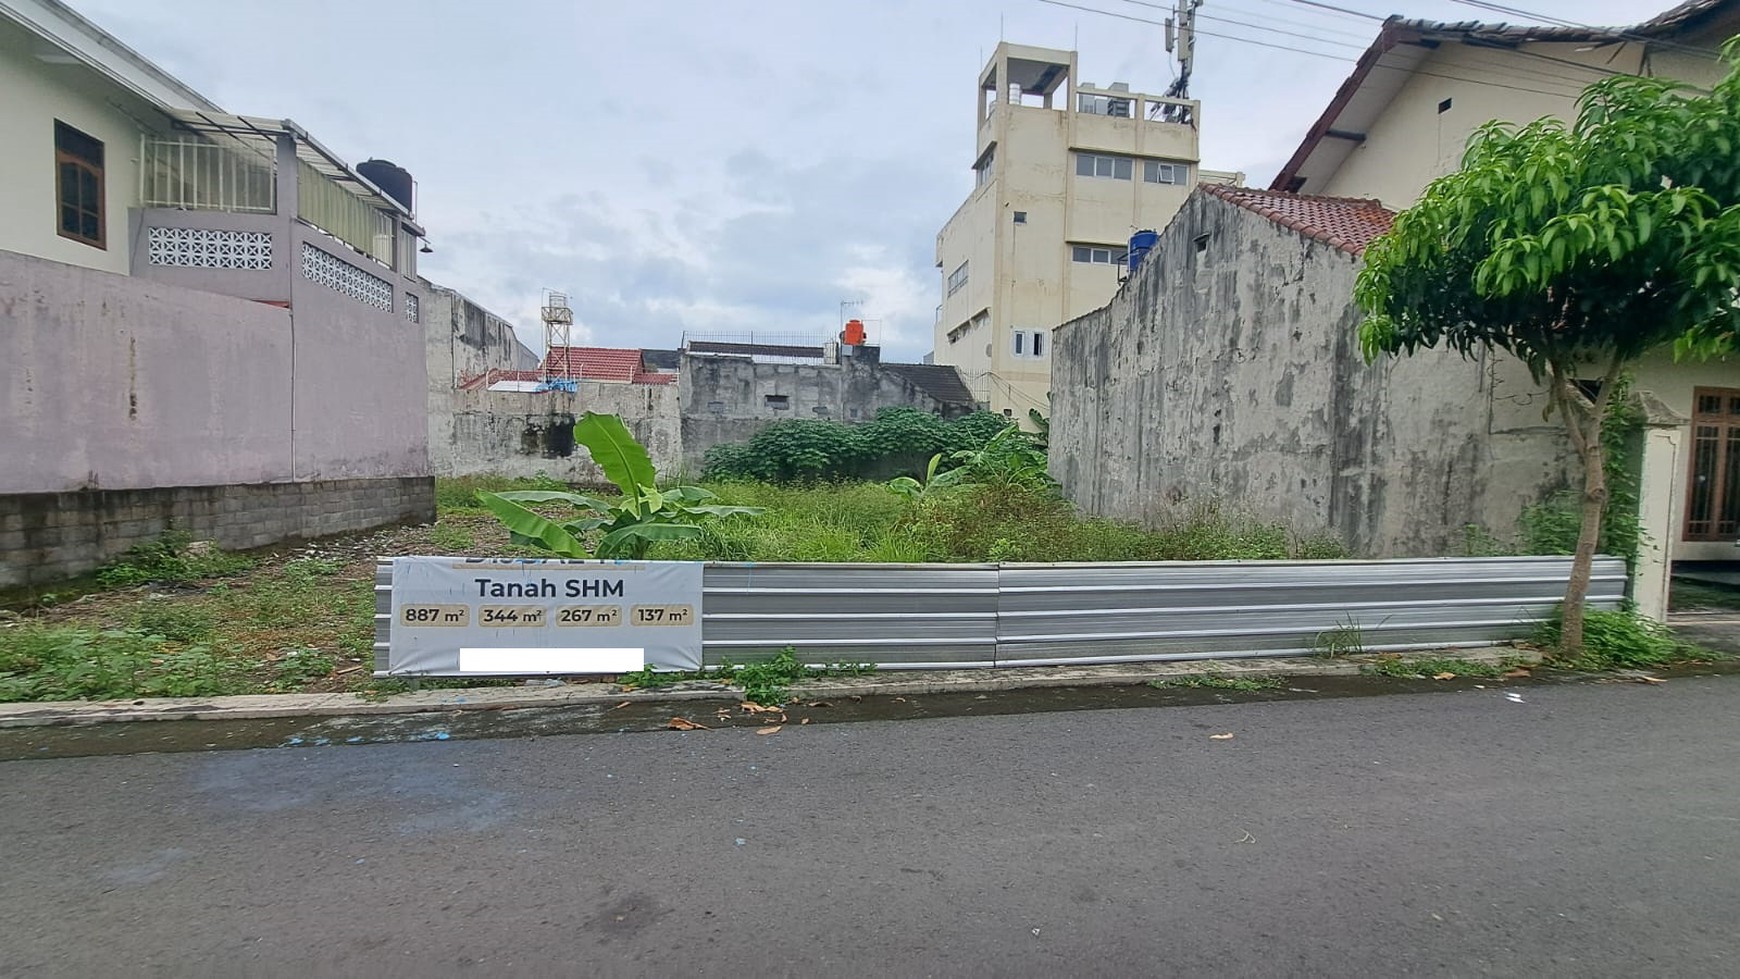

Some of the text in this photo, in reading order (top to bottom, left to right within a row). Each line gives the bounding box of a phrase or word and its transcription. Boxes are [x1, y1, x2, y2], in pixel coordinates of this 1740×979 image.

[475, 578, 624, 598] Tanah SHM
[405, 609, 440, 623] 887
[483, 609, 518, 623] 344
[561, 609, 592, 623] 267
[638, 608, 665, 623] 137
